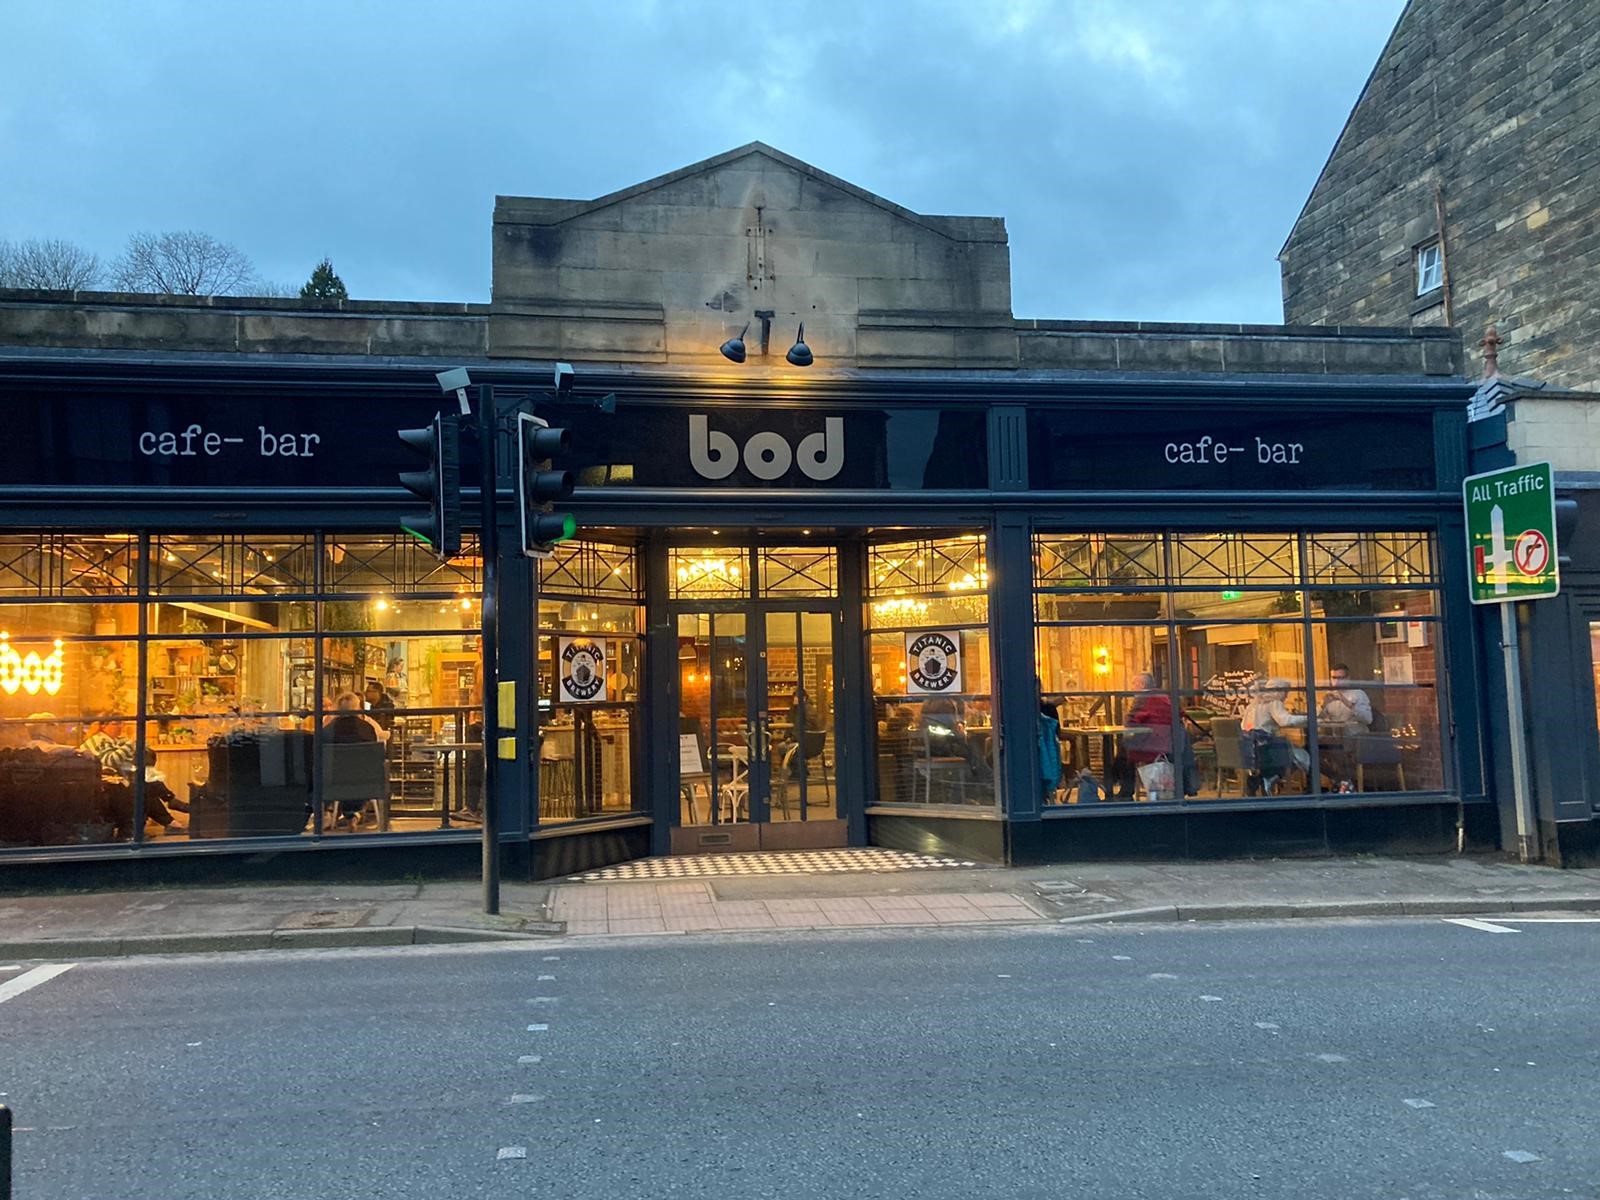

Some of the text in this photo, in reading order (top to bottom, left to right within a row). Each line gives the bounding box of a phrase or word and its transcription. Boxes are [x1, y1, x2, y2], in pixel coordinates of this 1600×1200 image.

[258, 426, 321, 457] bar
[689, 414, 845, 481] bod
[1255, 436, 1304, 464] bar
[1472, 474, 1545, 503] All Traffic
[912, 636, 952, 653] TITANIC
[566, 680, 600, 696] BREWERY
[913, 671, 953, 688] BREWERY
